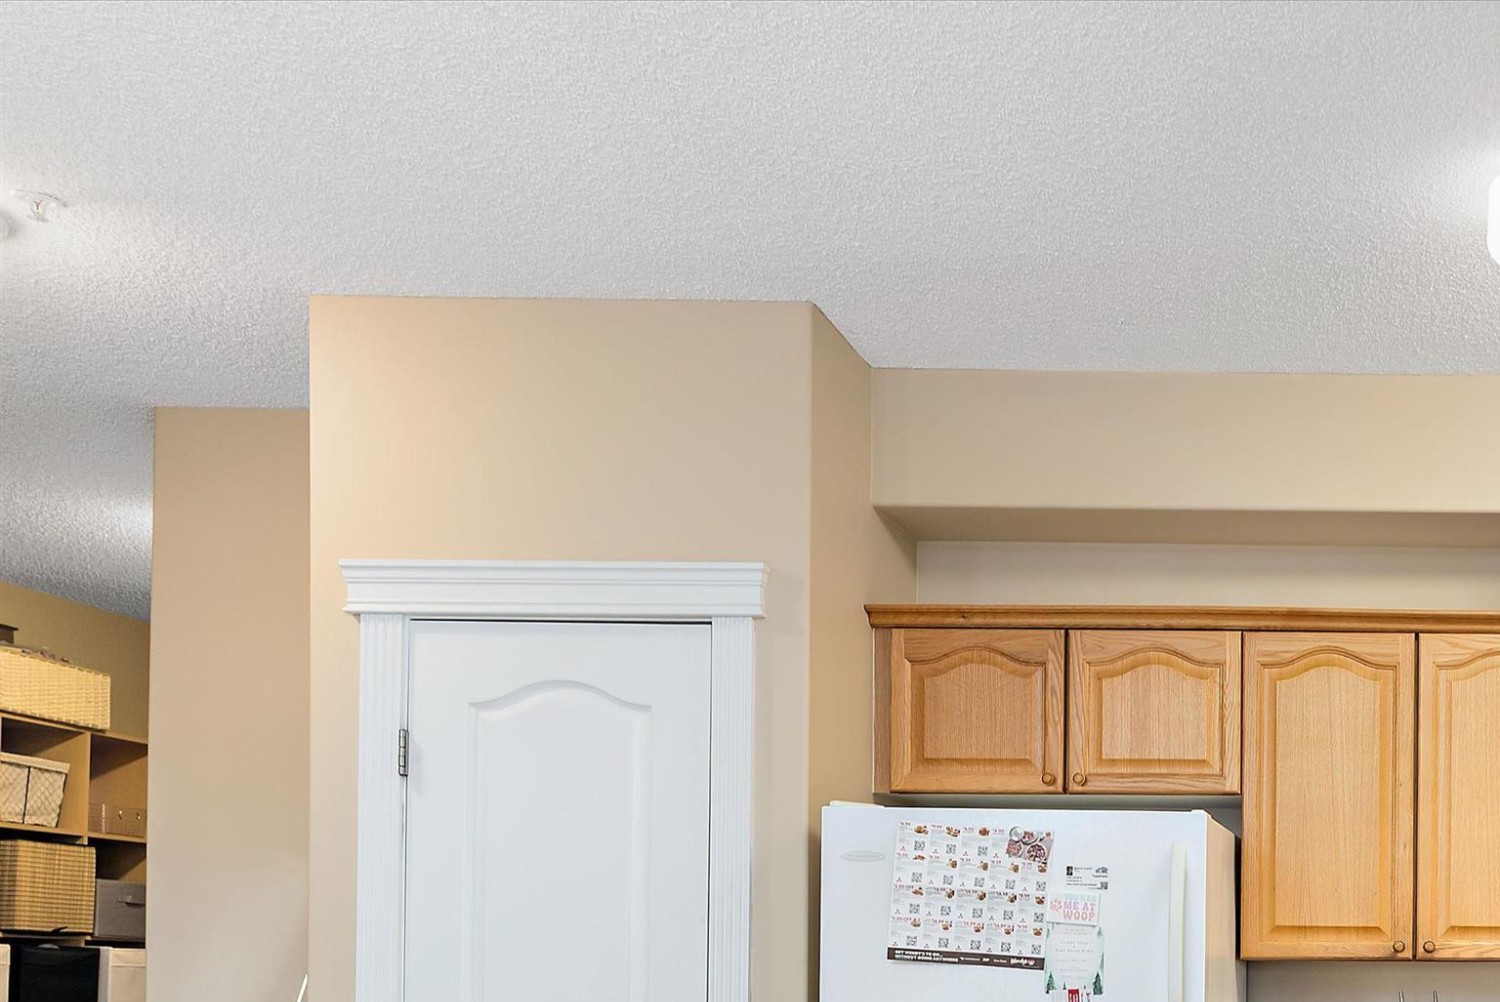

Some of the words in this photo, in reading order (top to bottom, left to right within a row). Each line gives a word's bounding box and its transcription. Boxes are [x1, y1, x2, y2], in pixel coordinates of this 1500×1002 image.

[1063, 901, 1079, 910] ME
[1082, 903, 1096, 911] AT
[1063, 910, 1096, 921] WOOF
